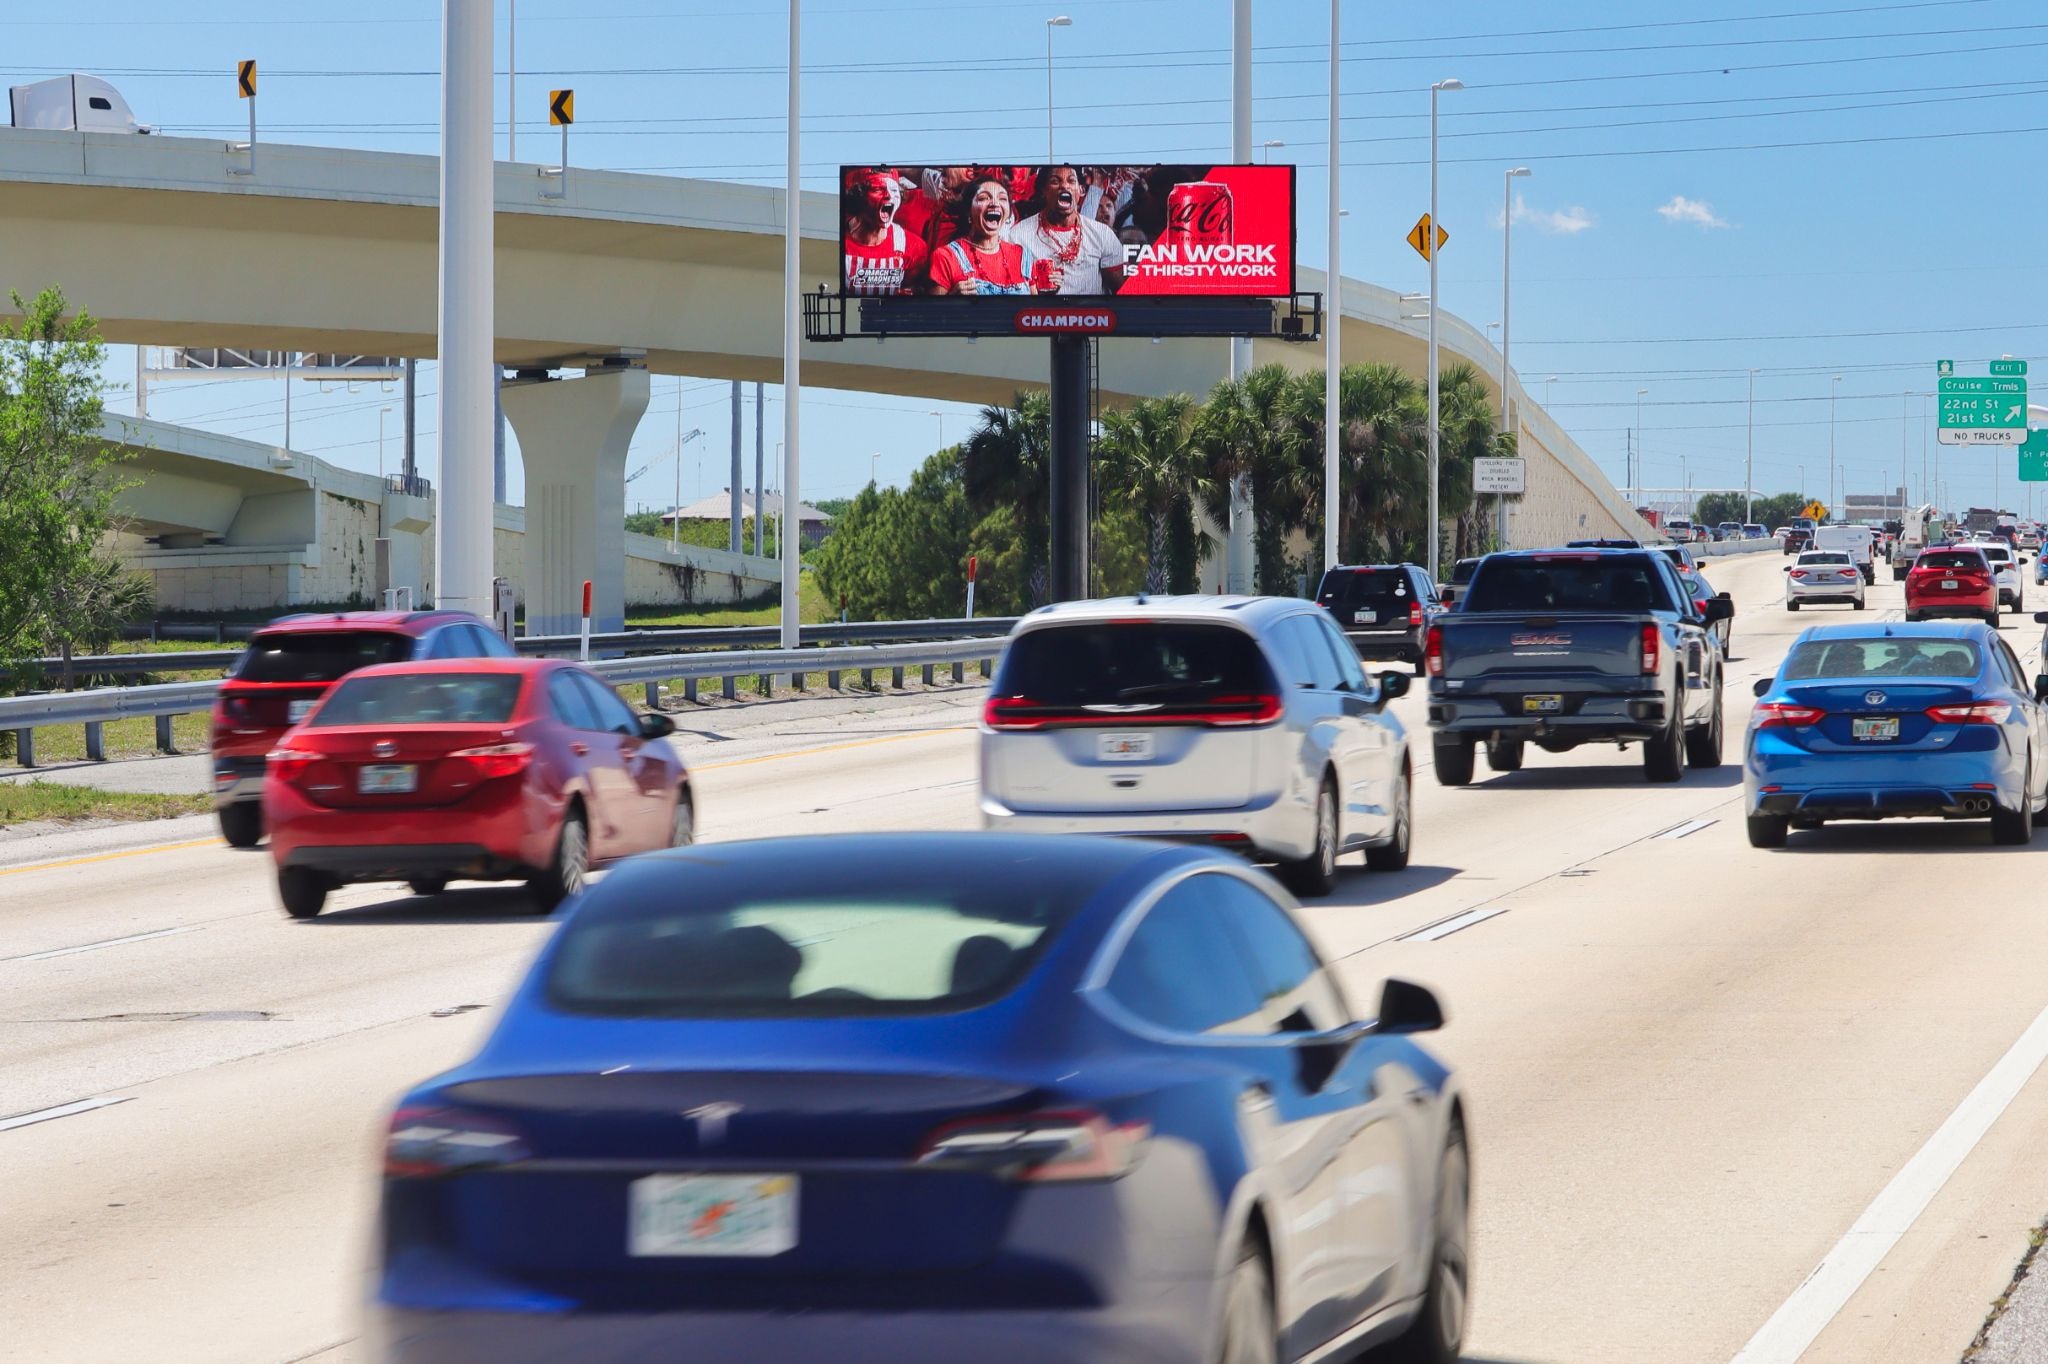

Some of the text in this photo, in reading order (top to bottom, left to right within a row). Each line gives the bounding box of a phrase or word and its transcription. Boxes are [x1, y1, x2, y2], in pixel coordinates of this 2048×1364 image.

[1122, 244, 1276, 263] FAN WORK
[1122, 264, 1277, 277] IS THIRSTY WORK
[867, 275, 900, 283] MADNESS
[1021, 315, 1109, 327] CHAMPION
[1995, 363, 2022, 373] EXIT 1
[1945, 381, 2019, 391] Cruise Trmls
[1944, 399, 1999, 409] 22nd St
[1947, 413, 1996, 423] 21st St
[1954, 432, 2011, 441] NO TRUCKS
[2023, 450, 2032, 458] St
